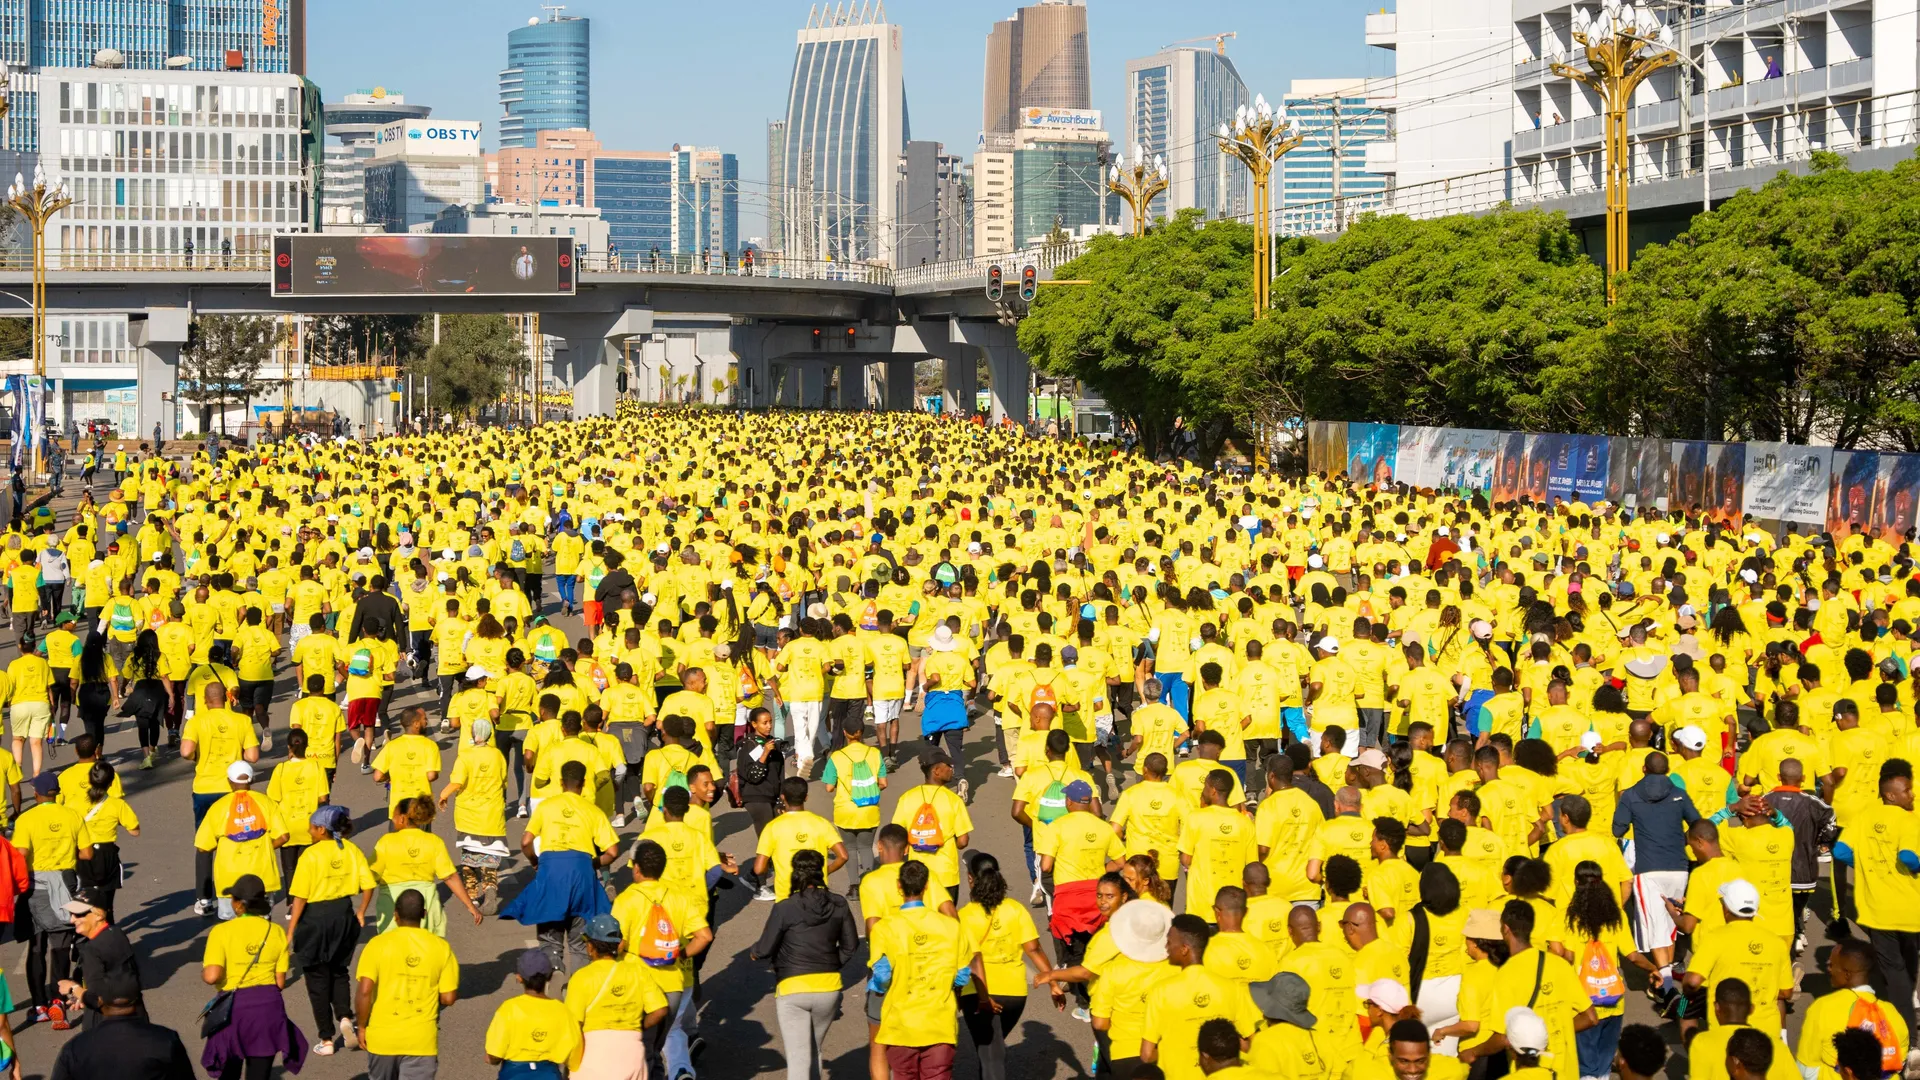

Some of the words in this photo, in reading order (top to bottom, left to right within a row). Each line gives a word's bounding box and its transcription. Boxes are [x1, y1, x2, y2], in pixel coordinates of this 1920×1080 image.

[356, 87, 402, 97] ETHIPIAN
[1047, 114, 1096, 124] AwashBank
[384, 127, 395, 142] OBS
[396, 126, 404, 140] TV
[426, 128, 457, 140] OBS
[460, 130, 480, 140] TV
